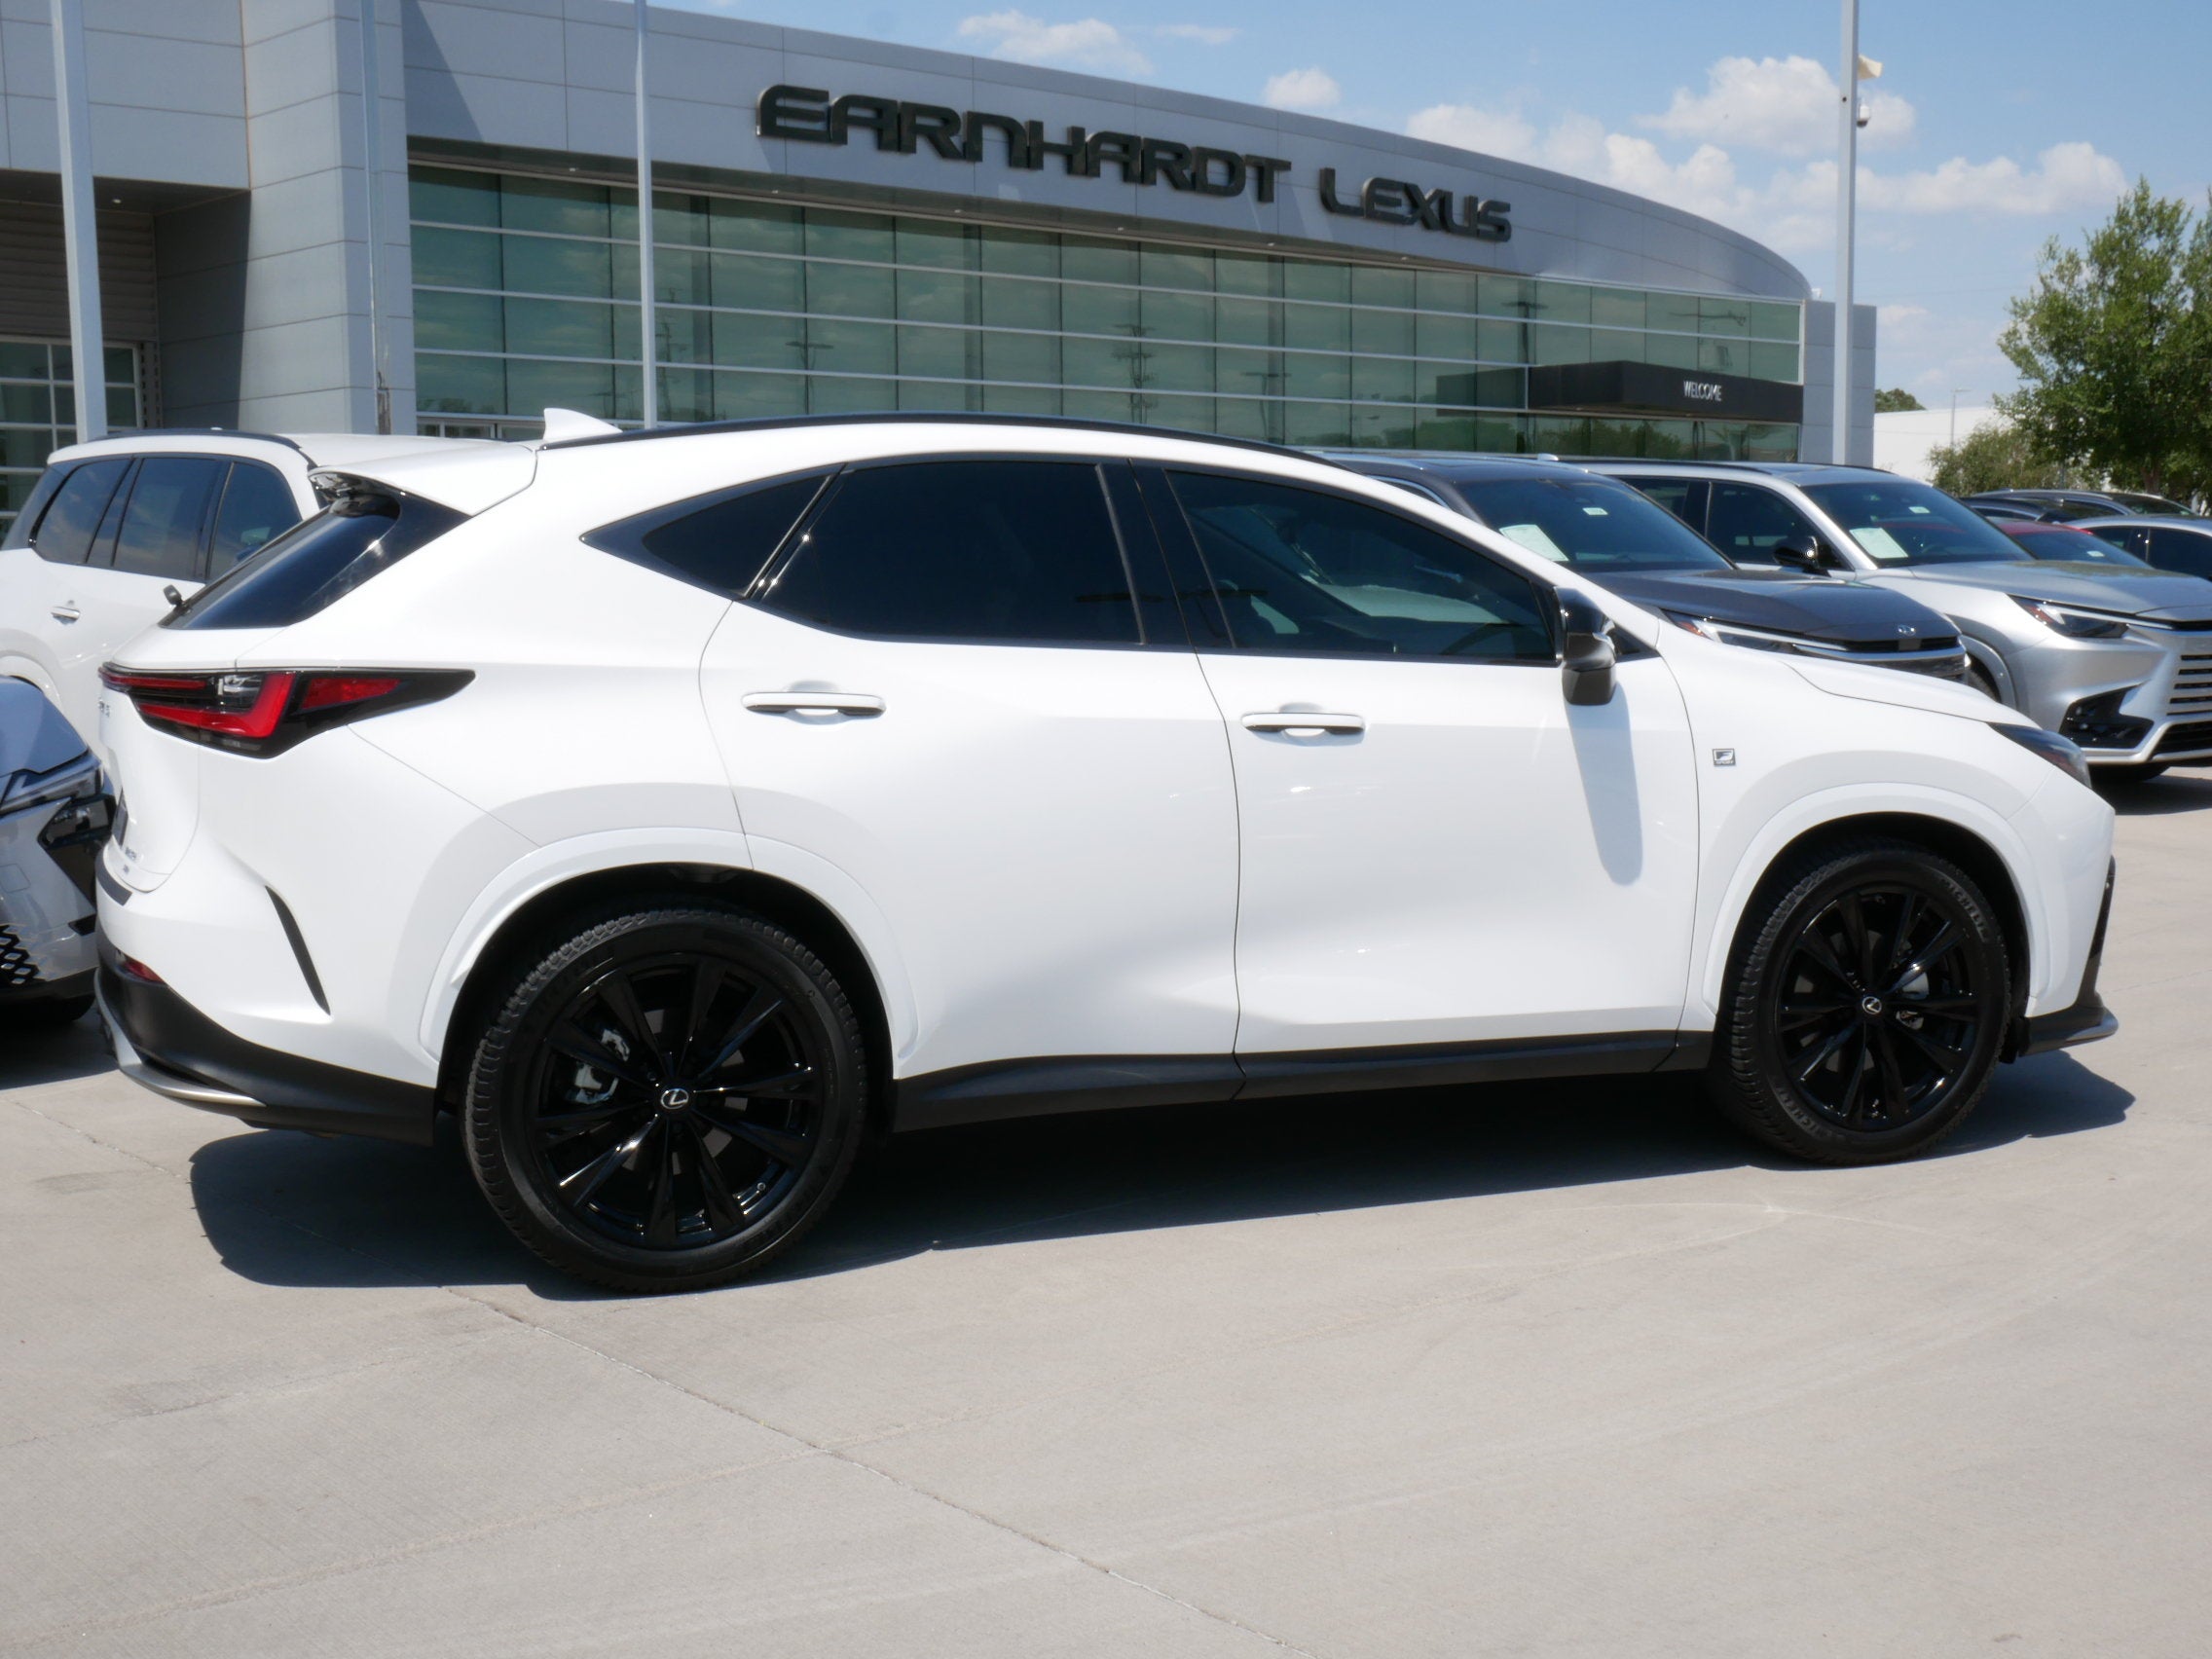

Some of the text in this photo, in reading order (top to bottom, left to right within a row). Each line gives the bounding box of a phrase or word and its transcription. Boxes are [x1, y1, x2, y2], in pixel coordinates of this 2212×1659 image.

[756, 85, 1512, 242] EARNHARDT LEXUS
[1683, 381, 1722, 401] WELCOME
